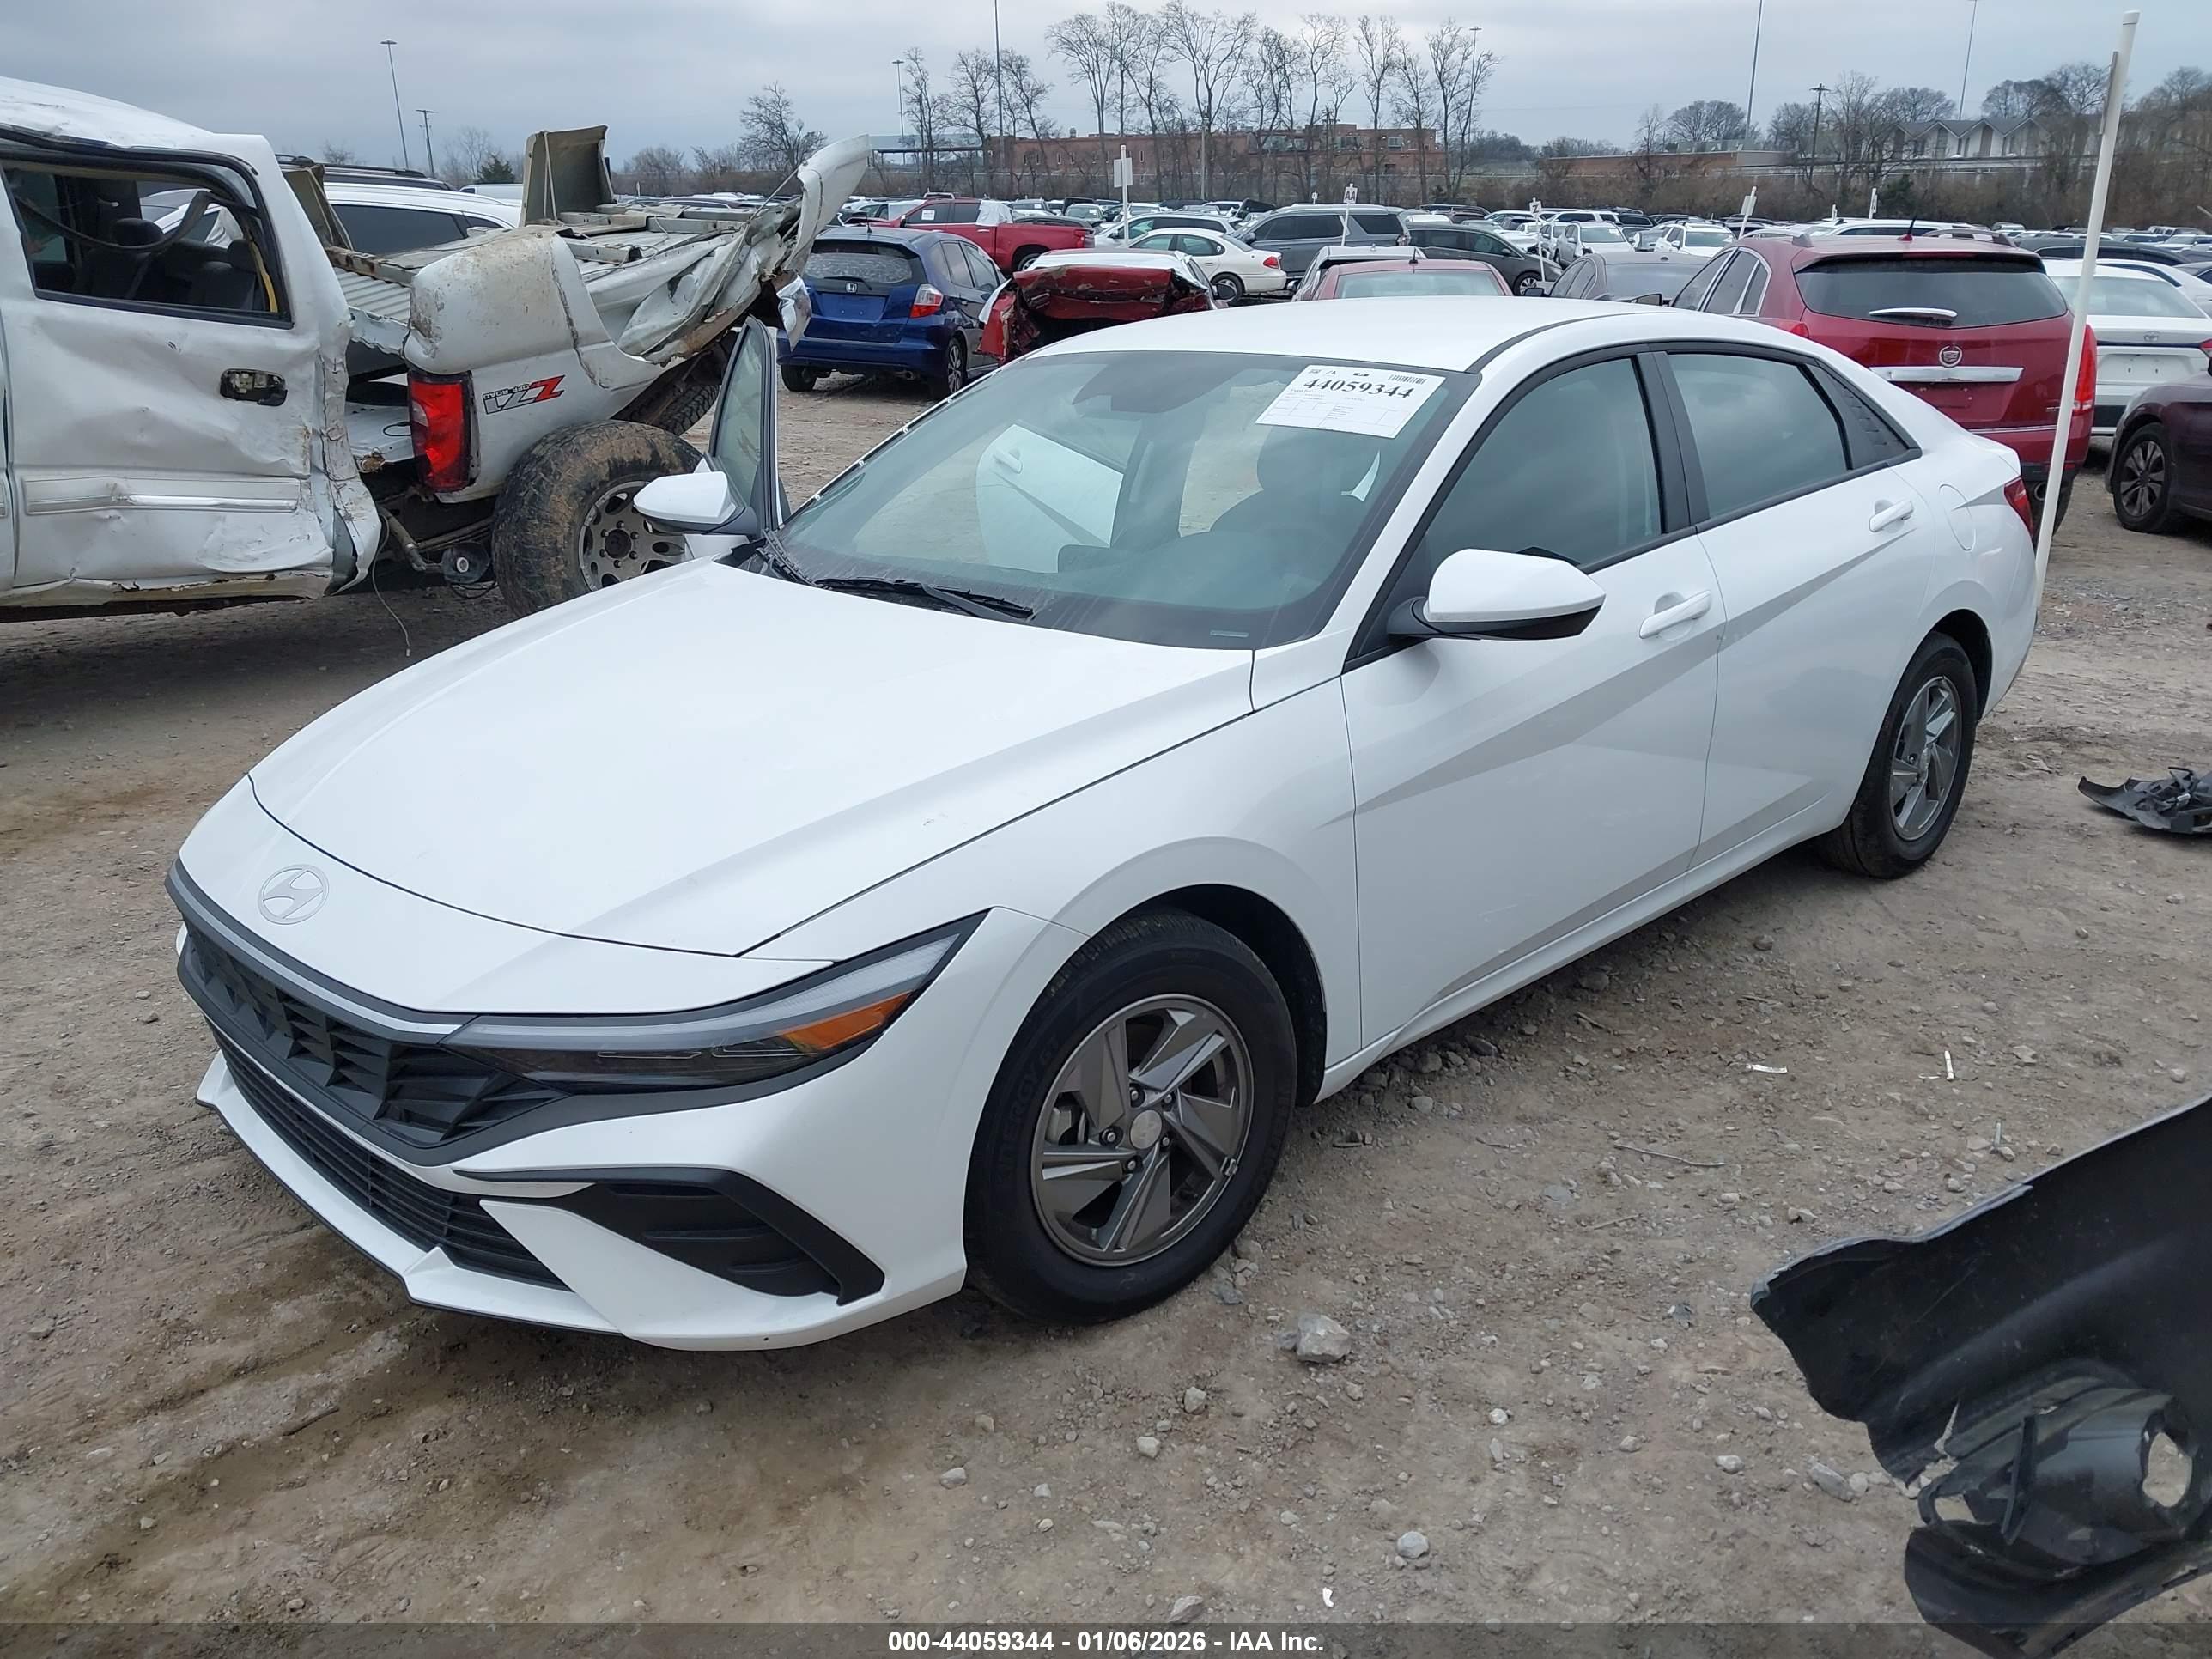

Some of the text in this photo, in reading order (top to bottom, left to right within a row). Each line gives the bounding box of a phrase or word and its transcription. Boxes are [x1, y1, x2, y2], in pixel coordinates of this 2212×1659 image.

[1345, 191, 1356, 200] AA
[483, 383, 531, 400] OFF ROAD
[1304, 379, 1414, 398] 44059344
